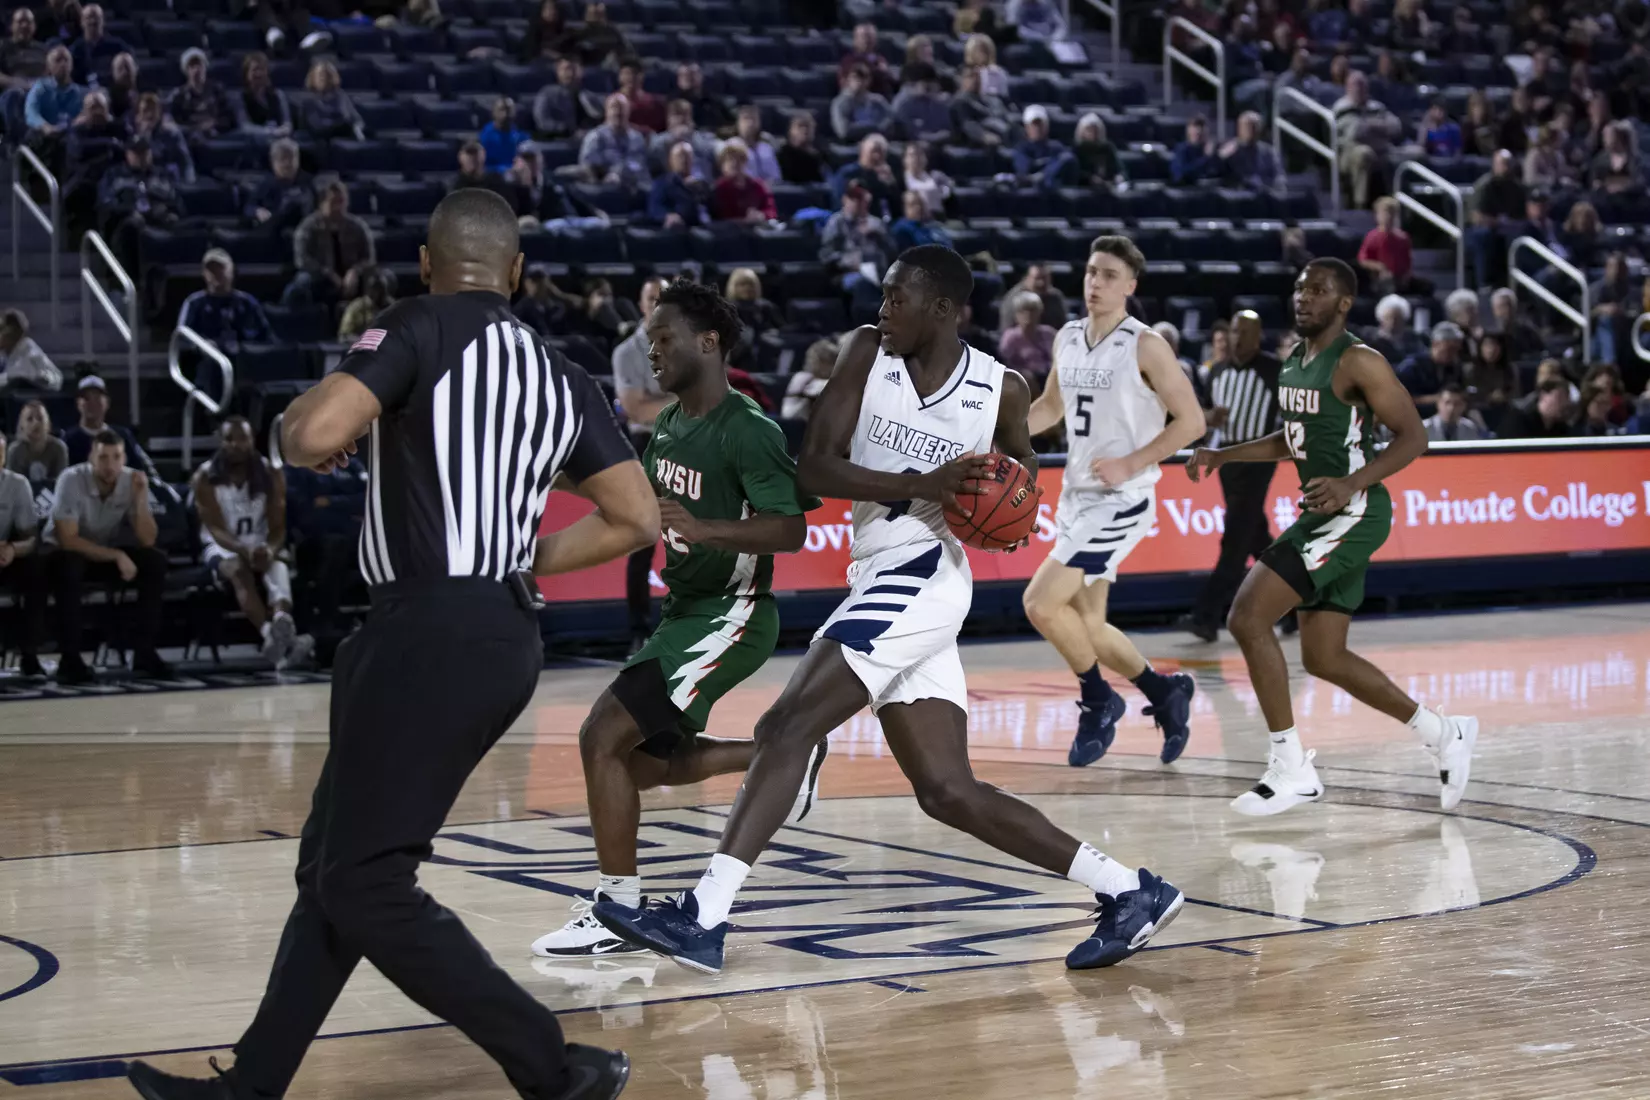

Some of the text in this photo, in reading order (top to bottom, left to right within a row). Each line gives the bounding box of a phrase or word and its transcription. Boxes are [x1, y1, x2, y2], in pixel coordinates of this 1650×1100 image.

[1061, 367, 1114, 390] LANCERS
[961, 399, 984, 410] WAC
[1074, 394, 1094, 437] 5
[1278, 386, 1320, 414] MVSU
[867, 415, 964, 467] LANCERS
[656, 458, 702, 500] MVSU
[1162, 498, 1226, 536] Vot
[1403, 489, 1516, 527] Private
[1522, 482, 1637, 527] College
